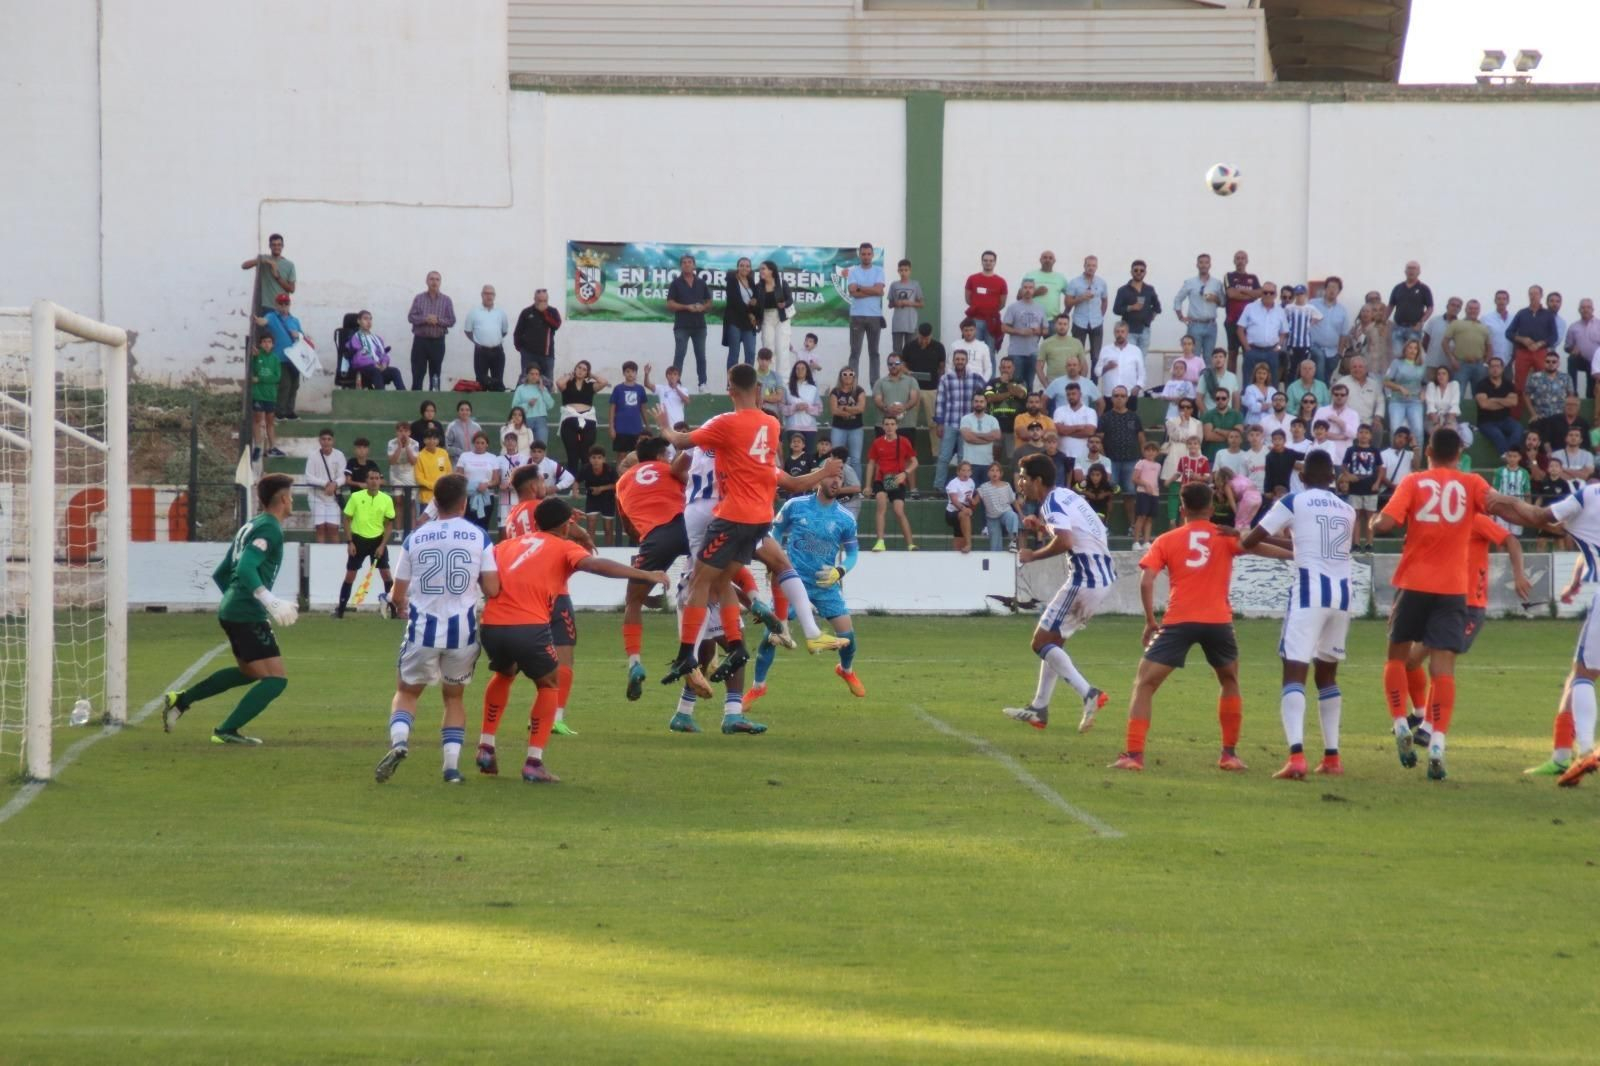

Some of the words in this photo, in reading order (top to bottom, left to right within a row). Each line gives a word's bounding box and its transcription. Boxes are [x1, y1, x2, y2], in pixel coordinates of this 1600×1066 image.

[616, 287, 639, 299] UN
[617, 268, 645, 283] EN
[652, 268, 727, 287] HOOR
[748, 425, 771, 464] 4
[634, 463, 660, 485] 6
[1415, 479, 1468, 523] 20
[453, 531, 477, 542] ROS
[508, 536, 546, 571] 7
[1185, 530, 1211, 568] 5
[1316, 514, 1350, 560] 12
[418, 548, 472, 595] 26
